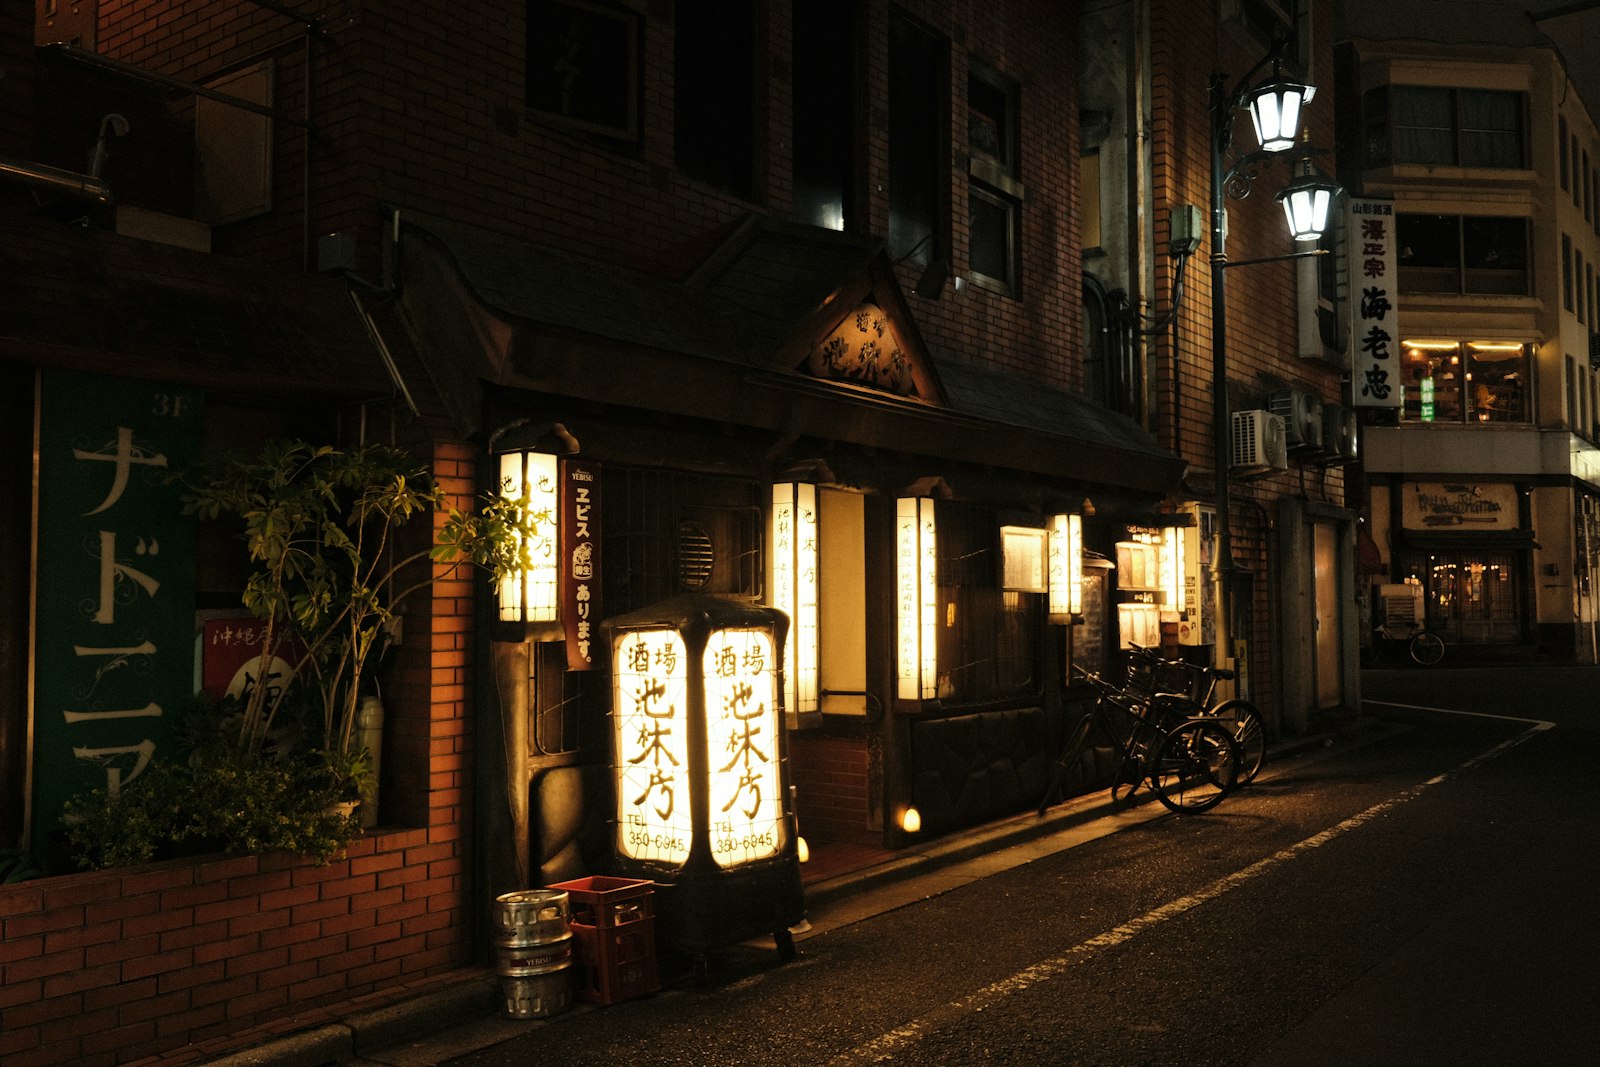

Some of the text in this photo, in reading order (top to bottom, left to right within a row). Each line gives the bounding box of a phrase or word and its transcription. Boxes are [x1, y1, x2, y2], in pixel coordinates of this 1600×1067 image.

[1361, 219, 1387, 279] 澤正宗
[1361, 286, 1392, 400] 海老忠
[152, 391, 192, 418] 3F
[571, 473, 594, 482] YEBISU
[575, 583, 592, 664] あります。
[628, 642, 677, 675] 酒場
[714, 645, 766, 677] 酒場
[627, 814, 647, 827] TEL
[714, 822, 735, 833] TEL
[629, 832, 685, 852] 350-6945
[716, 832, 773, 854] 350-6945
[525, 955, 552, 967] YEBISU
